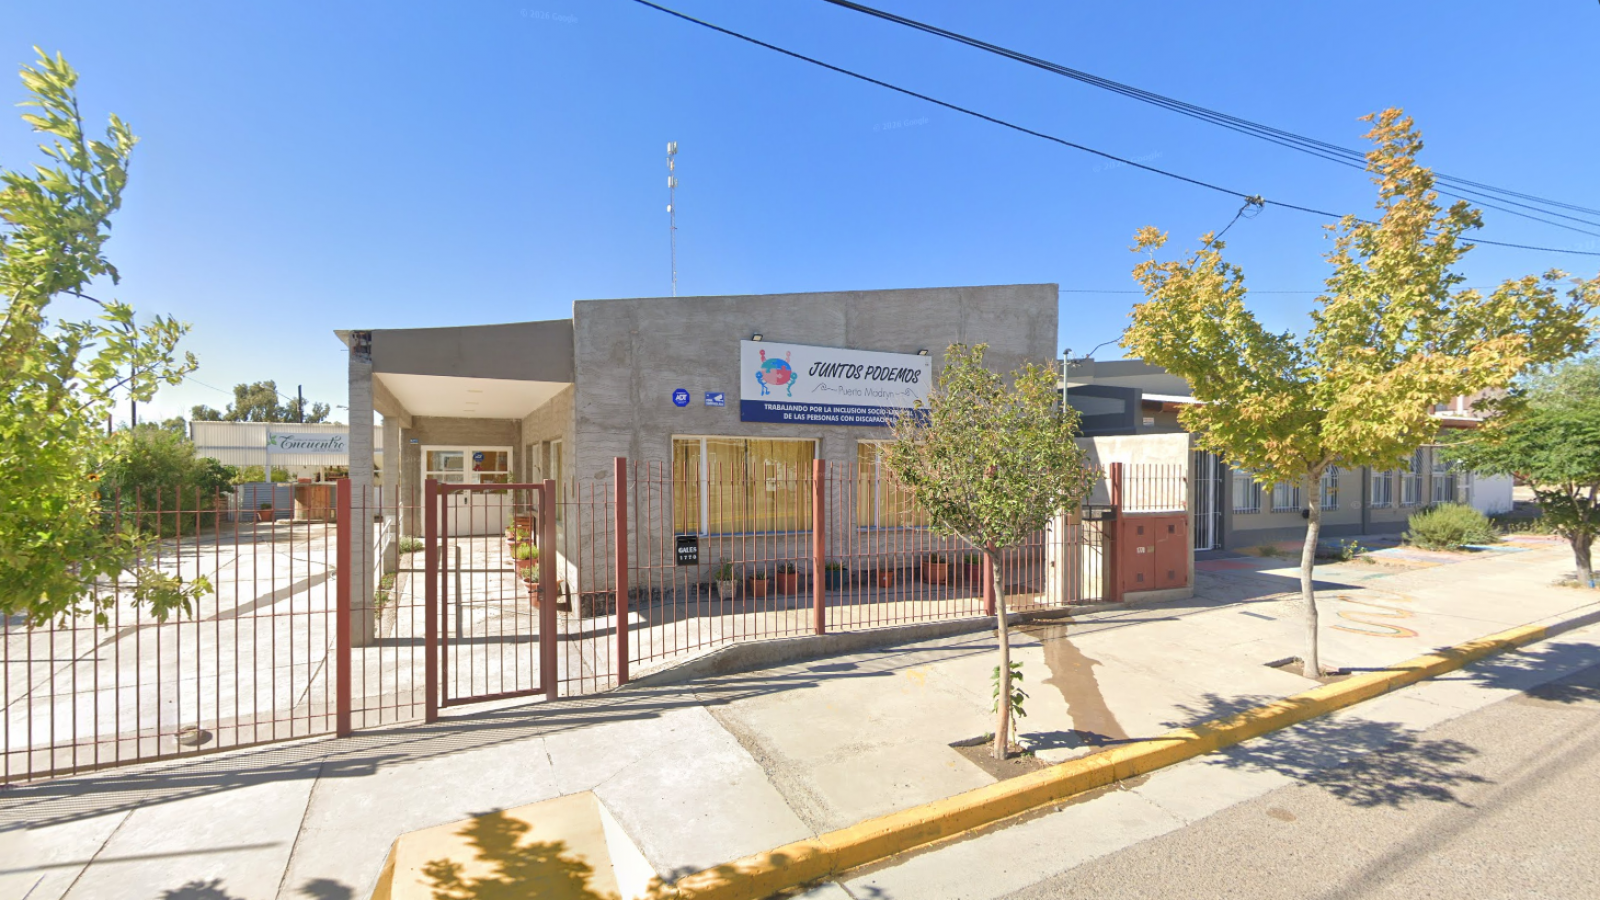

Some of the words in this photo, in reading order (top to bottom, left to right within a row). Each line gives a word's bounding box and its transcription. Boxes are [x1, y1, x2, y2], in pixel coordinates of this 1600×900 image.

[808, 361, 864, 380] JUNTOS
[864, 365, 922, 384] PODEMOS
[838, 385, 862, 397] Puerto
[864, 387, 895, 400] Madryn
[764, 403, 808, 412] TRABAJANDO
[833, 406, 867, 415] INCLUSION
[806, 414, 839, 422] PERSONAS
[279, 434, 345, 451] Encuentro
